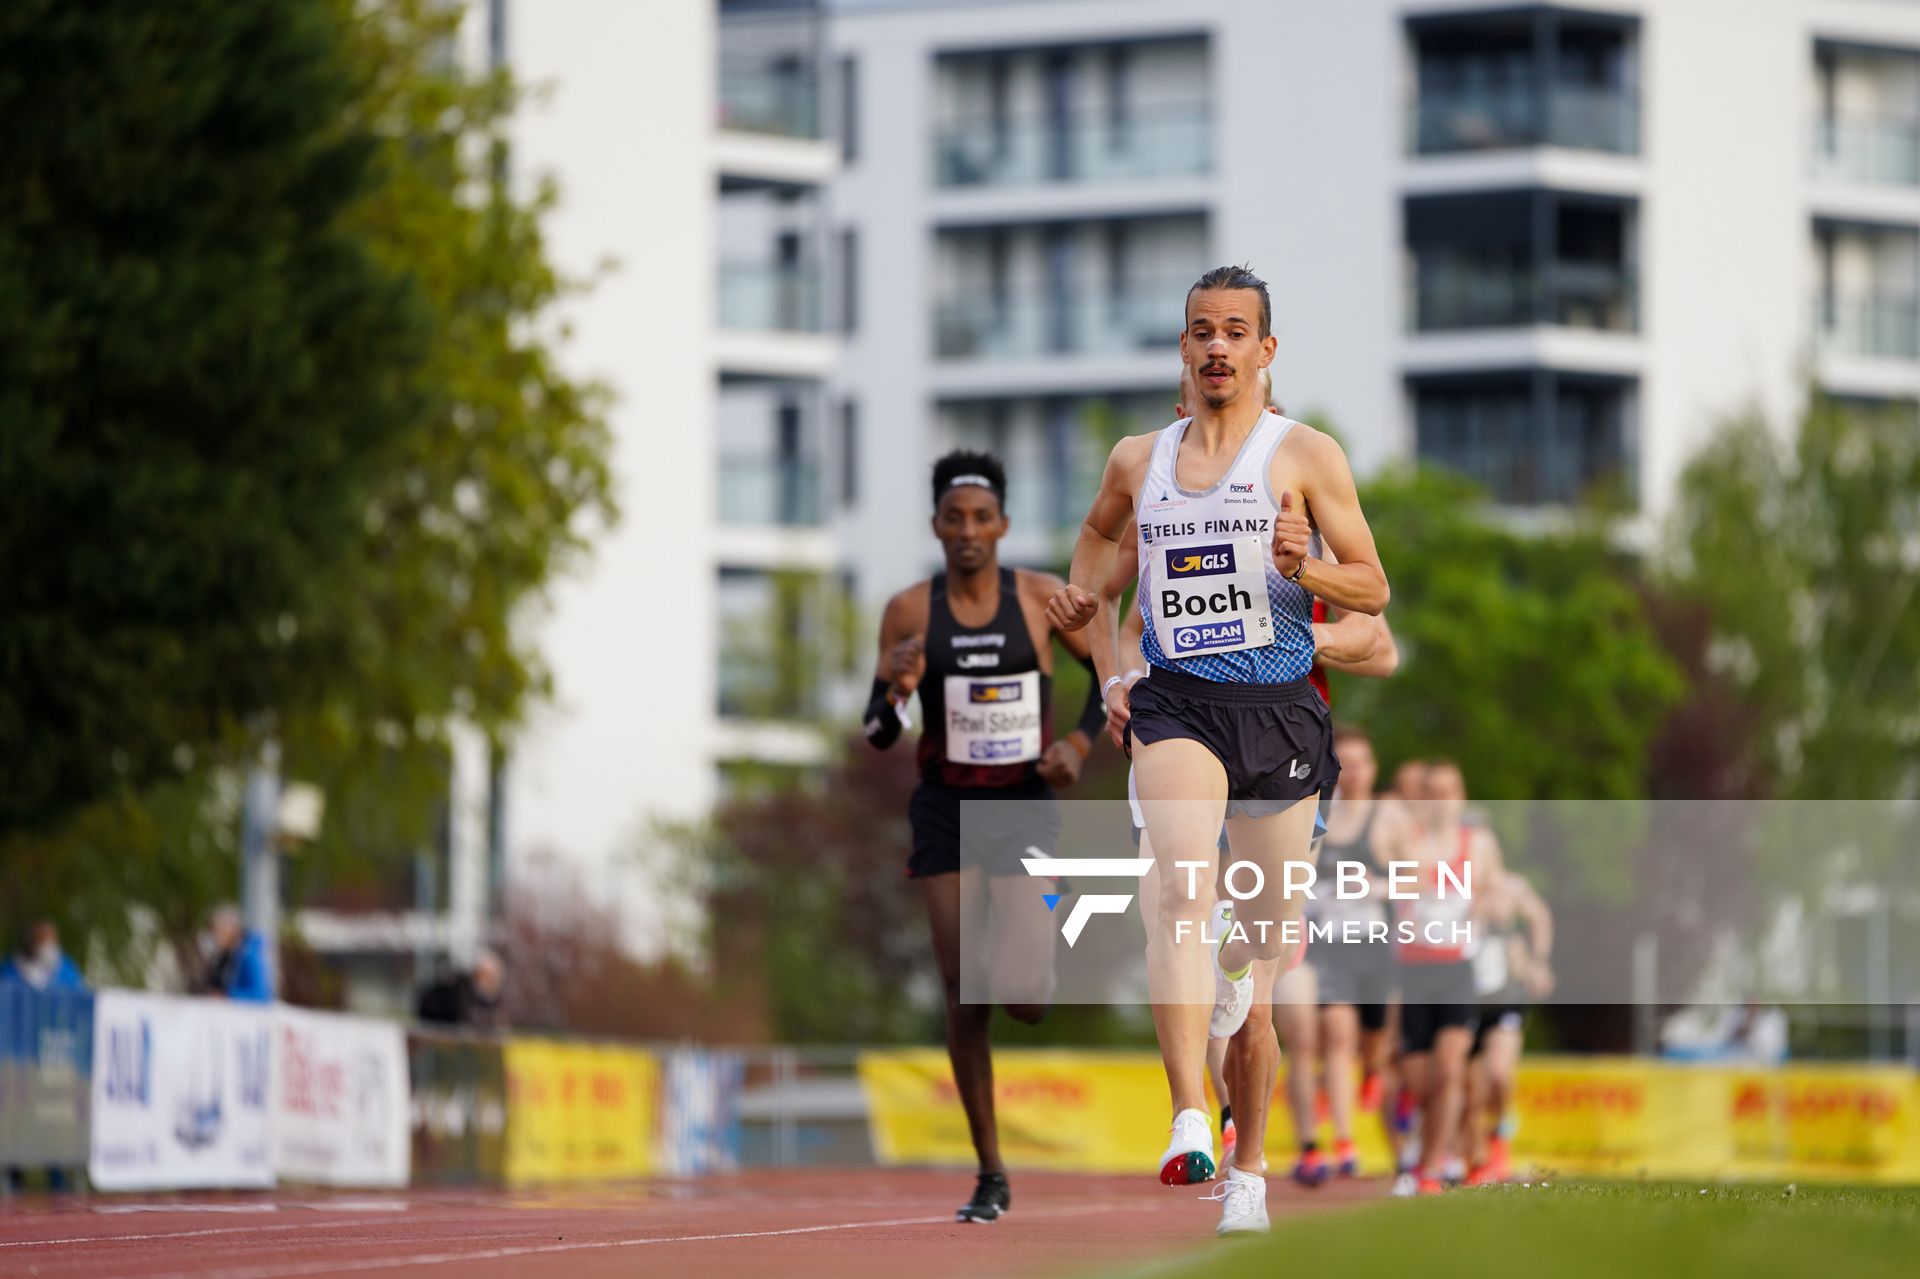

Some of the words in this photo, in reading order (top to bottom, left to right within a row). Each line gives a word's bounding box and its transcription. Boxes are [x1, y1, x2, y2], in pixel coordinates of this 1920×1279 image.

[1230, 483, 1254, 493] PEPPEX
[1154, 522, 1196, 538] TELIS
[1204, 519, 1269, 534] FINANZ
[1201, 552, 1229, 570] GLS
[1161, 583, 1252, 619] Boch
[1258, 616, 1268, 628] 58
[1202, 624, 1242, 640] PLAN
[1203, 637, 1243, 646] INTERNATIONAL
[951, 711, 985, 733] Fitwi
